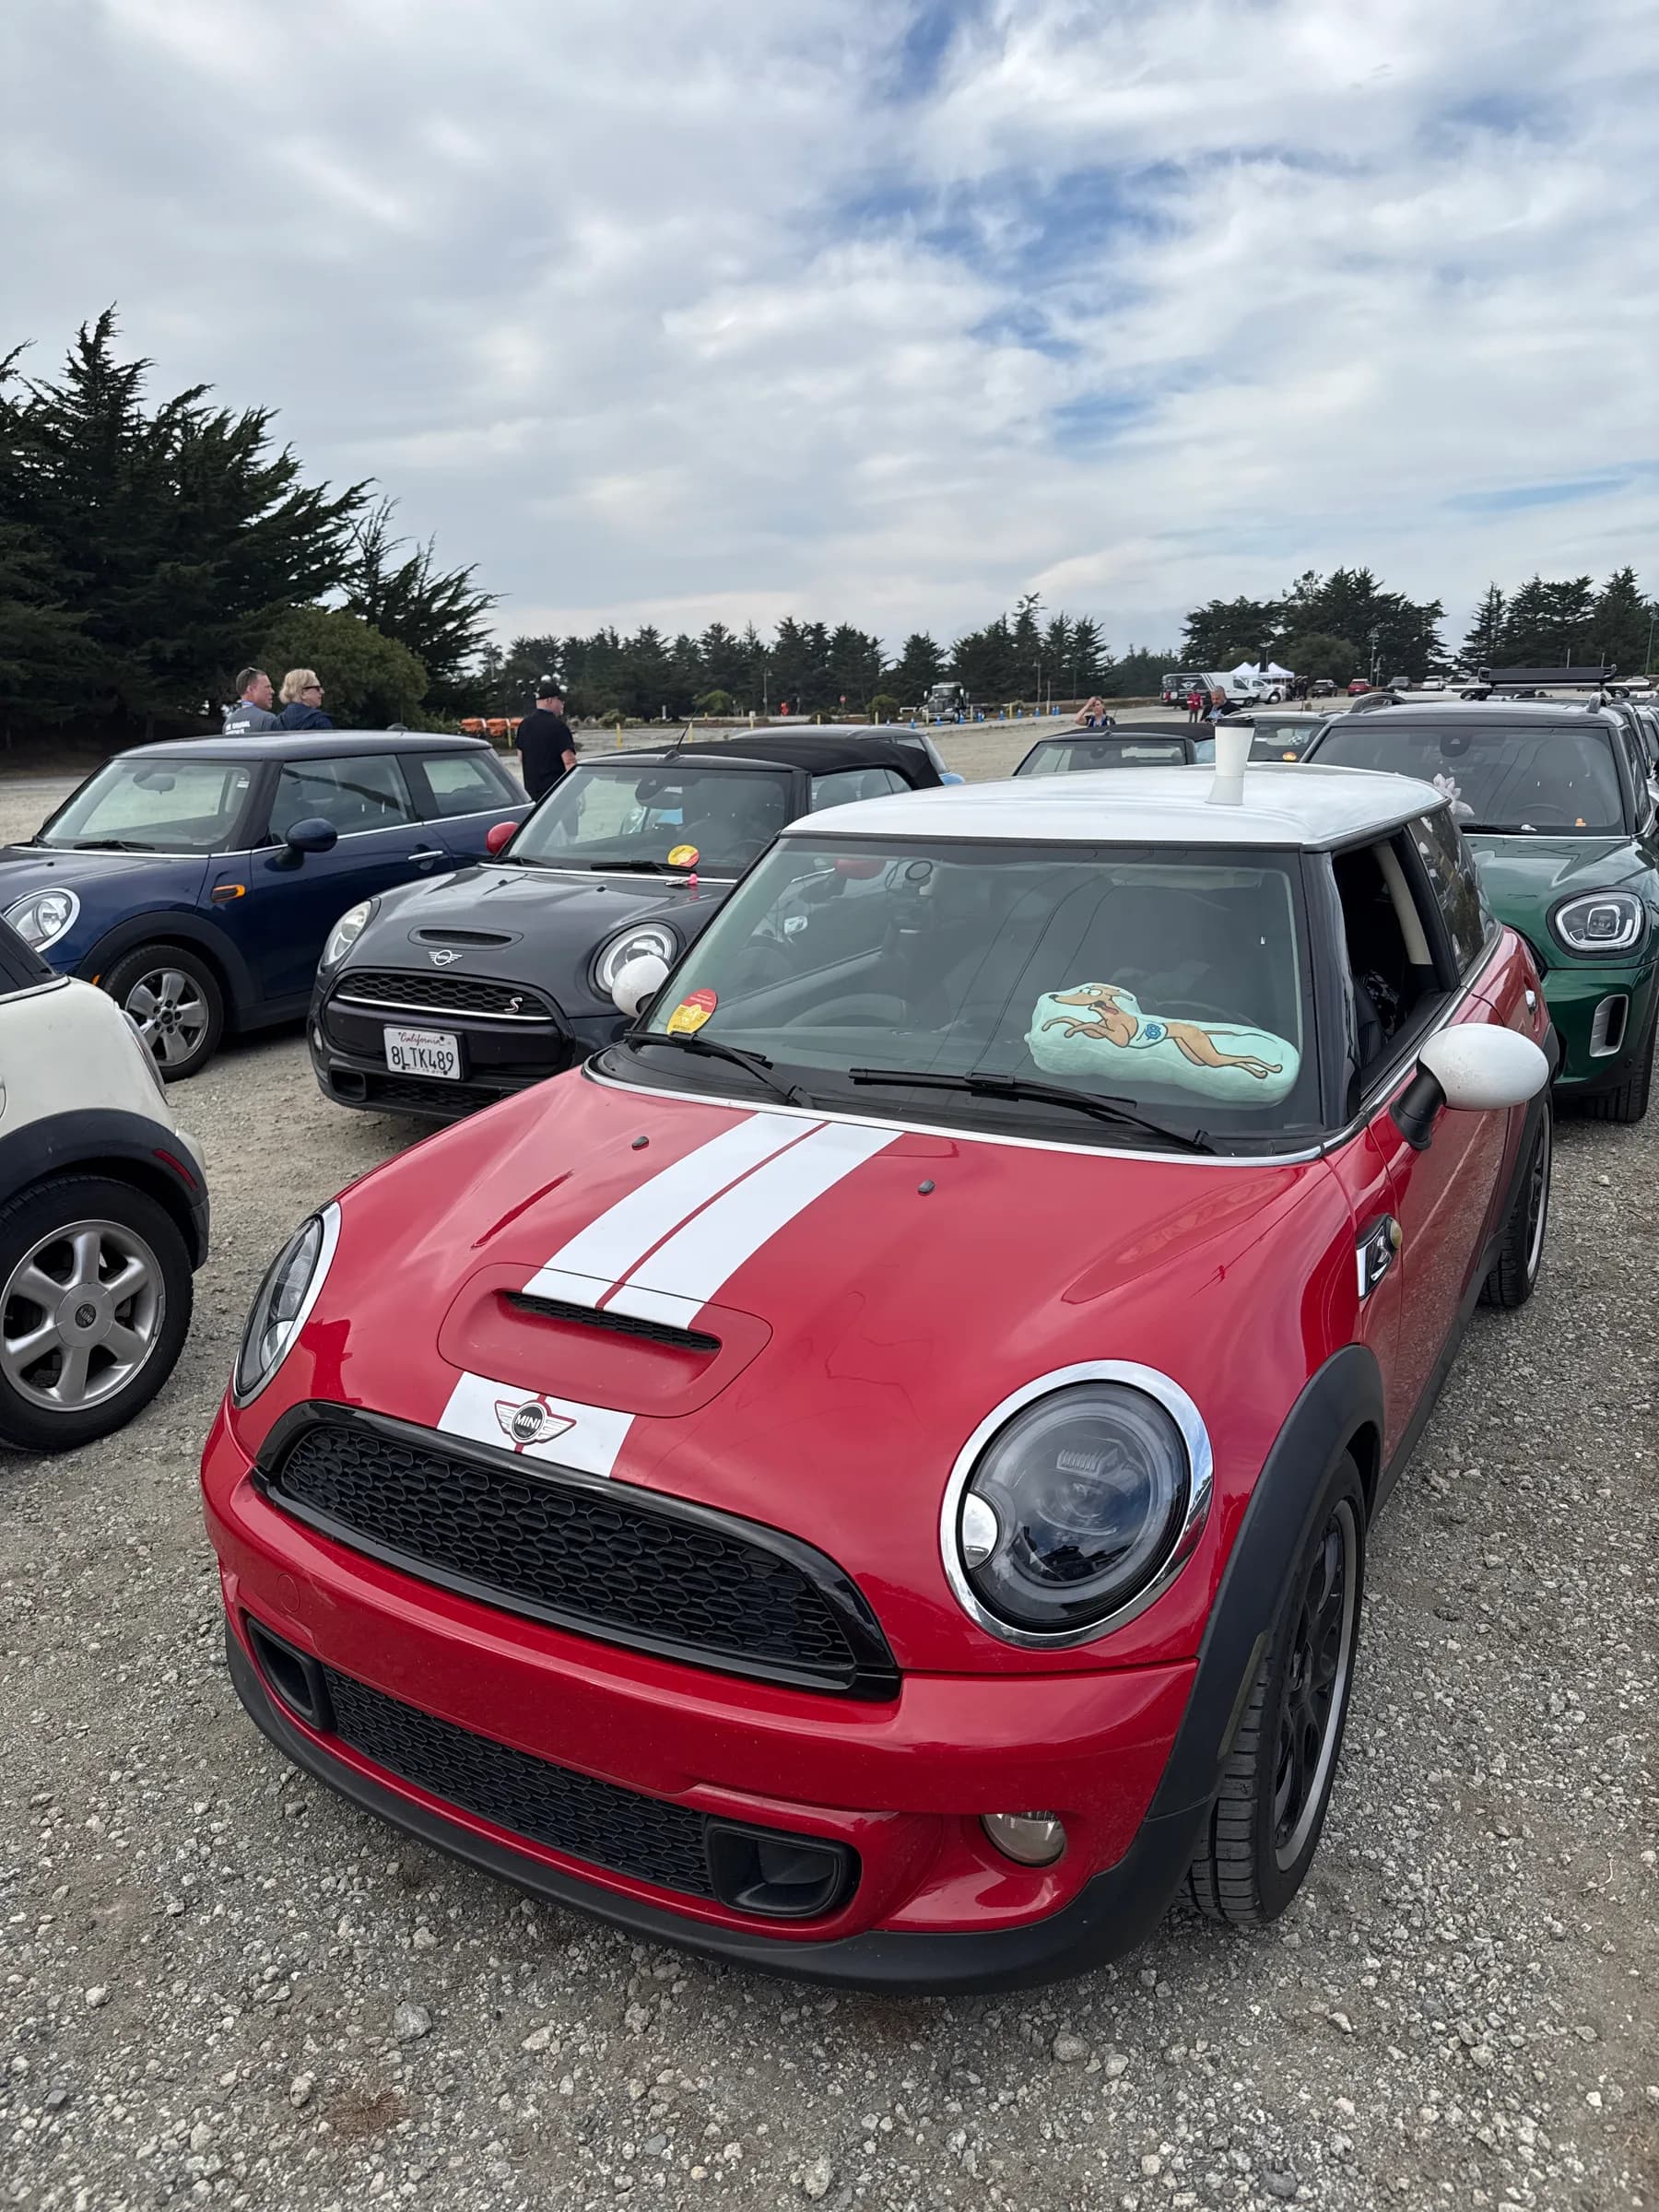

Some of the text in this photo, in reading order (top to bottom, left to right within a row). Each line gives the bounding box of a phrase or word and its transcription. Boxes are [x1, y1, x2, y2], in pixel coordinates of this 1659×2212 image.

[400, 1032, 444, 1046] California
[391, 1045, 454, 1072] 8LTK489
[515, 1414, 542, 1430] MINI
